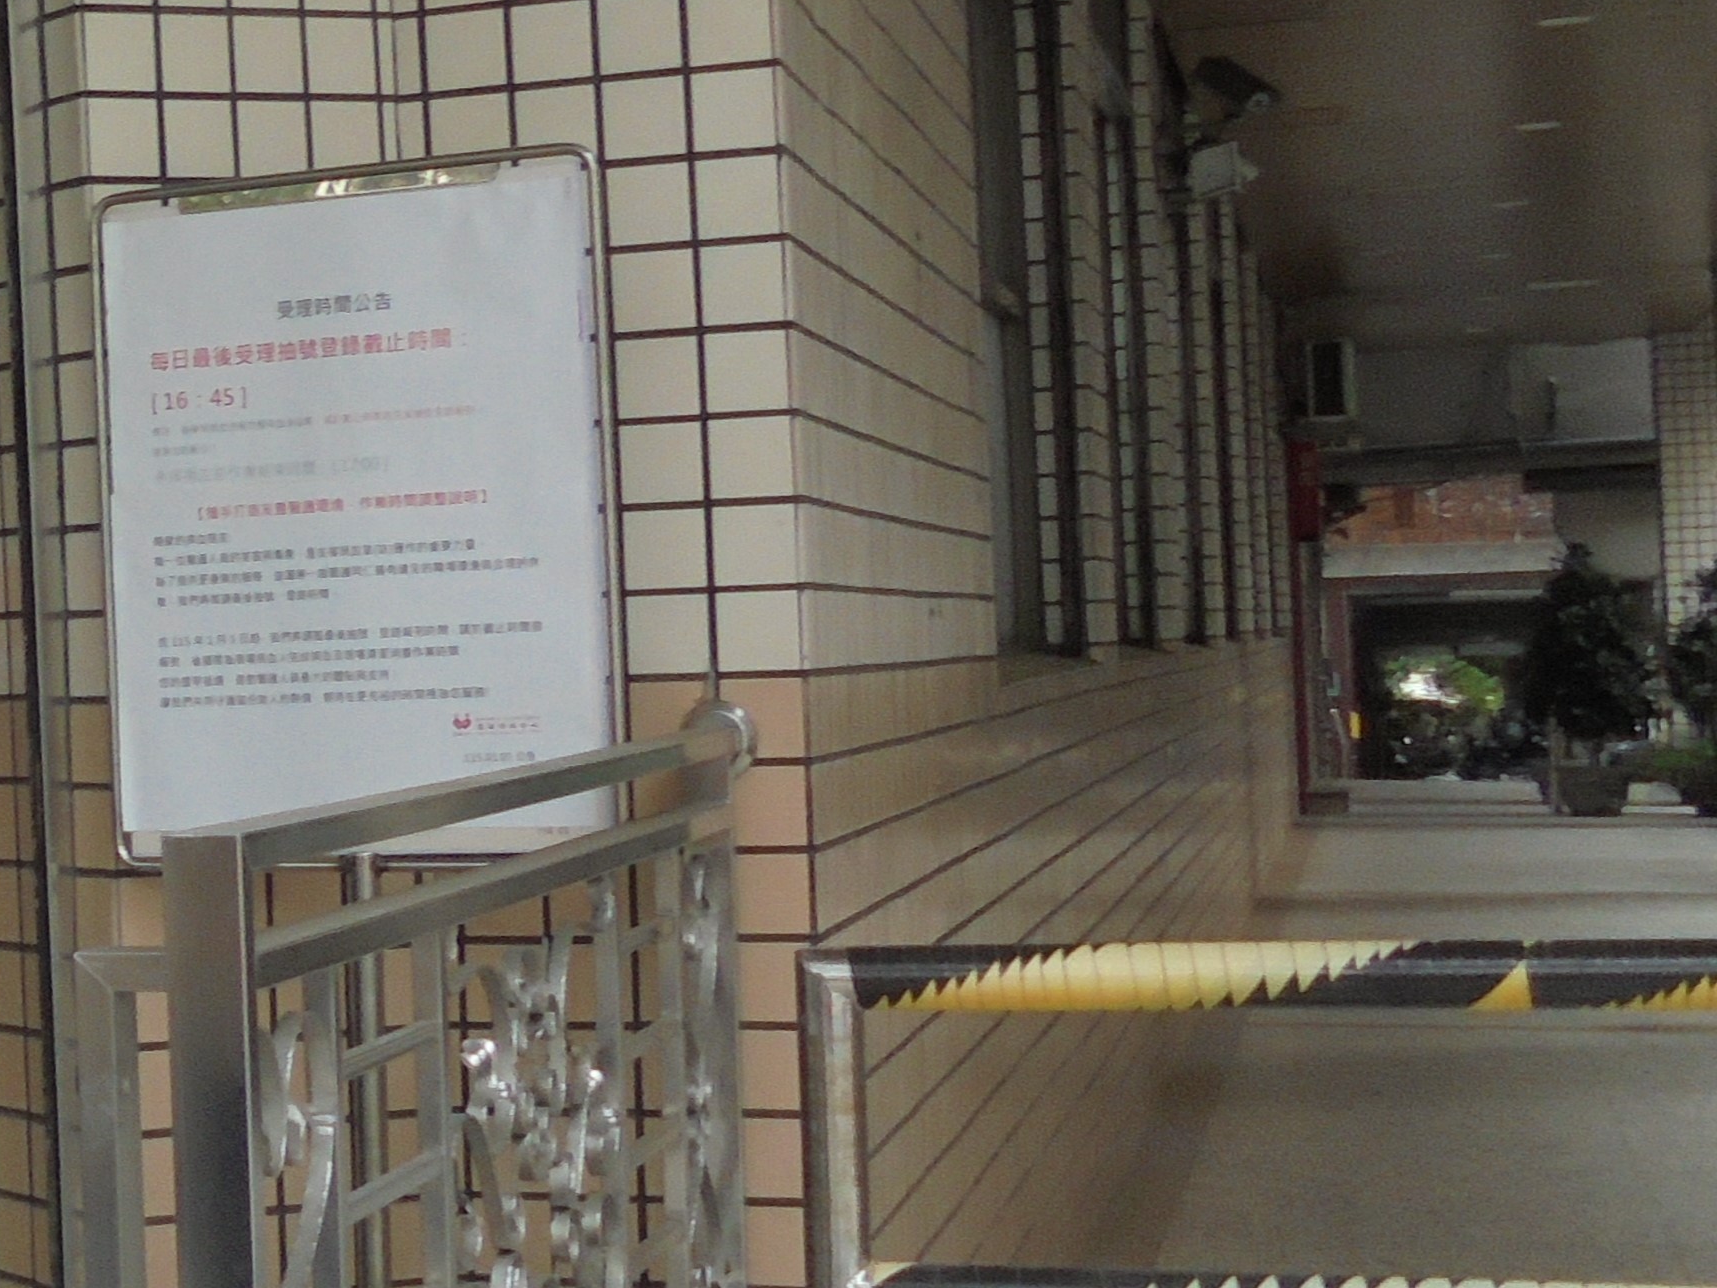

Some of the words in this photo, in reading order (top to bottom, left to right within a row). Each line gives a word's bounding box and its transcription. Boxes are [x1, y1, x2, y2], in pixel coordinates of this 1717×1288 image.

[277, 292, 393, 319] 受理時間公告
